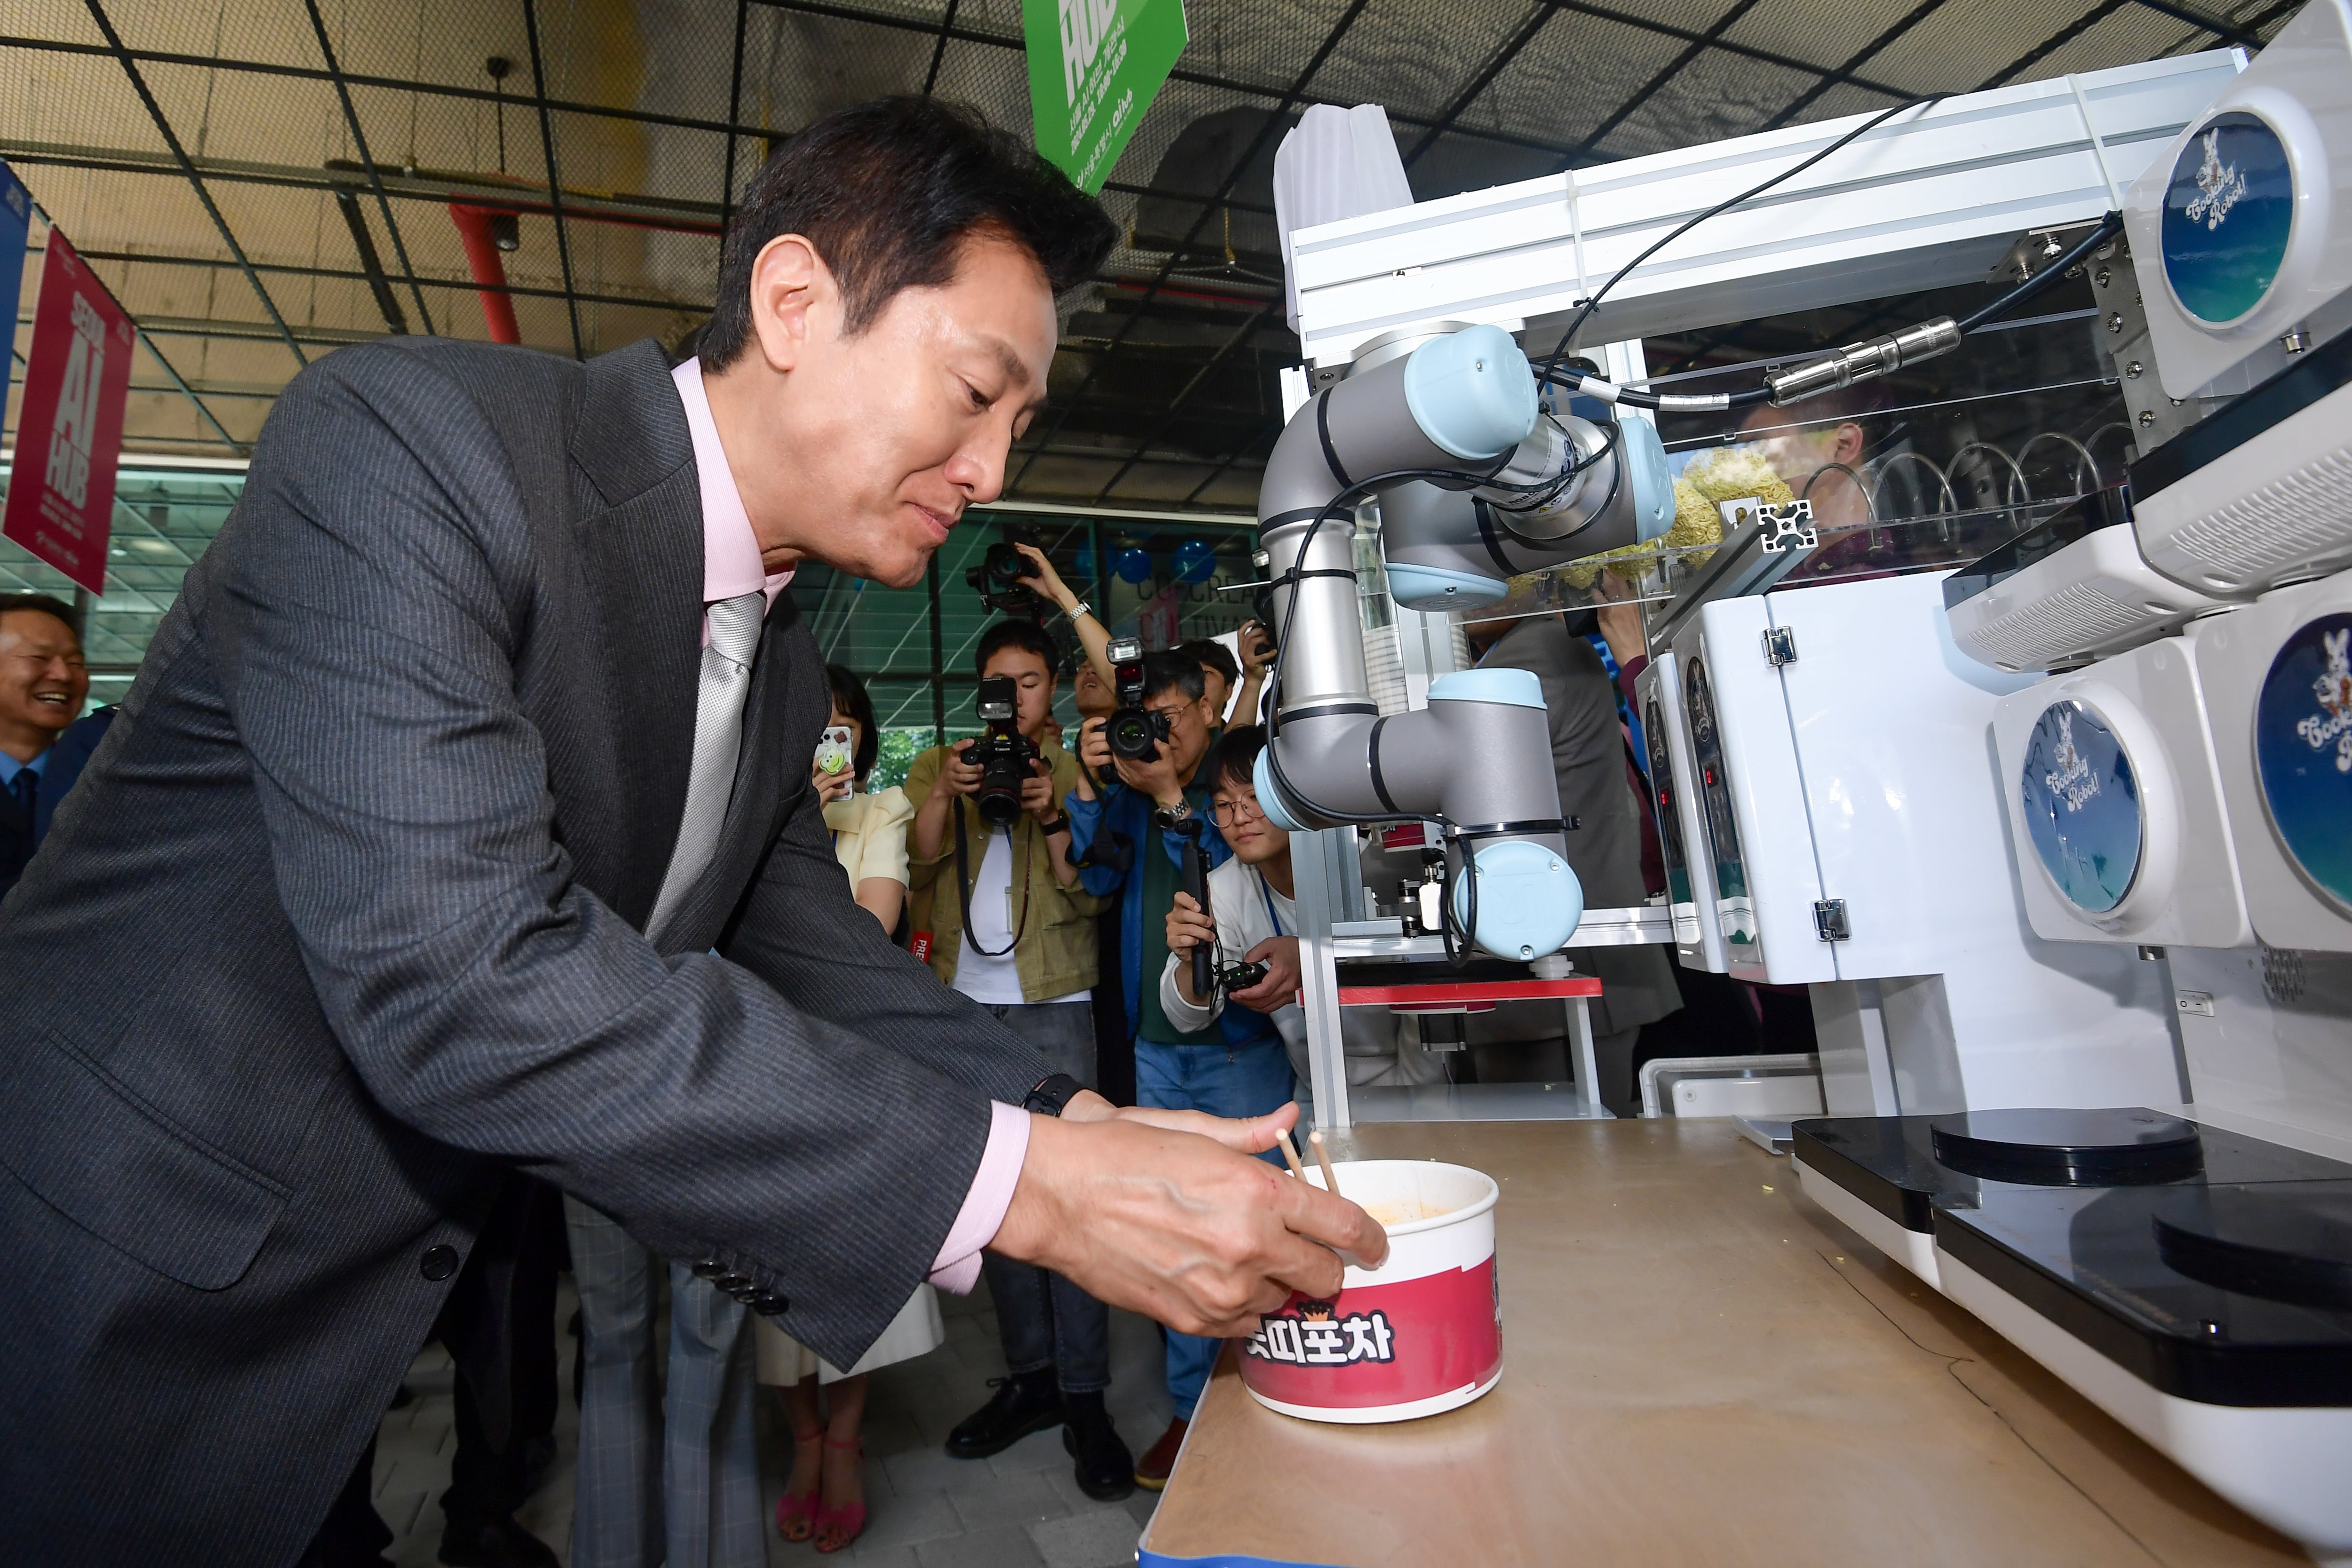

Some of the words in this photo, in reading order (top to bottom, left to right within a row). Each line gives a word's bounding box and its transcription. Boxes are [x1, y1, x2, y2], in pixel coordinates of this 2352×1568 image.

[2186, 165, 2235, 221] Cooking
[2208, 173, 2247, 230] Robot!
[53, 329, 104, 460] AI
[45, 428, 91, 509] HUB
[2045, 758, 2089, 795] Cooking
[2067, 771, 2100, 812] Robot!
[915, 939, 927, 960] PRE
